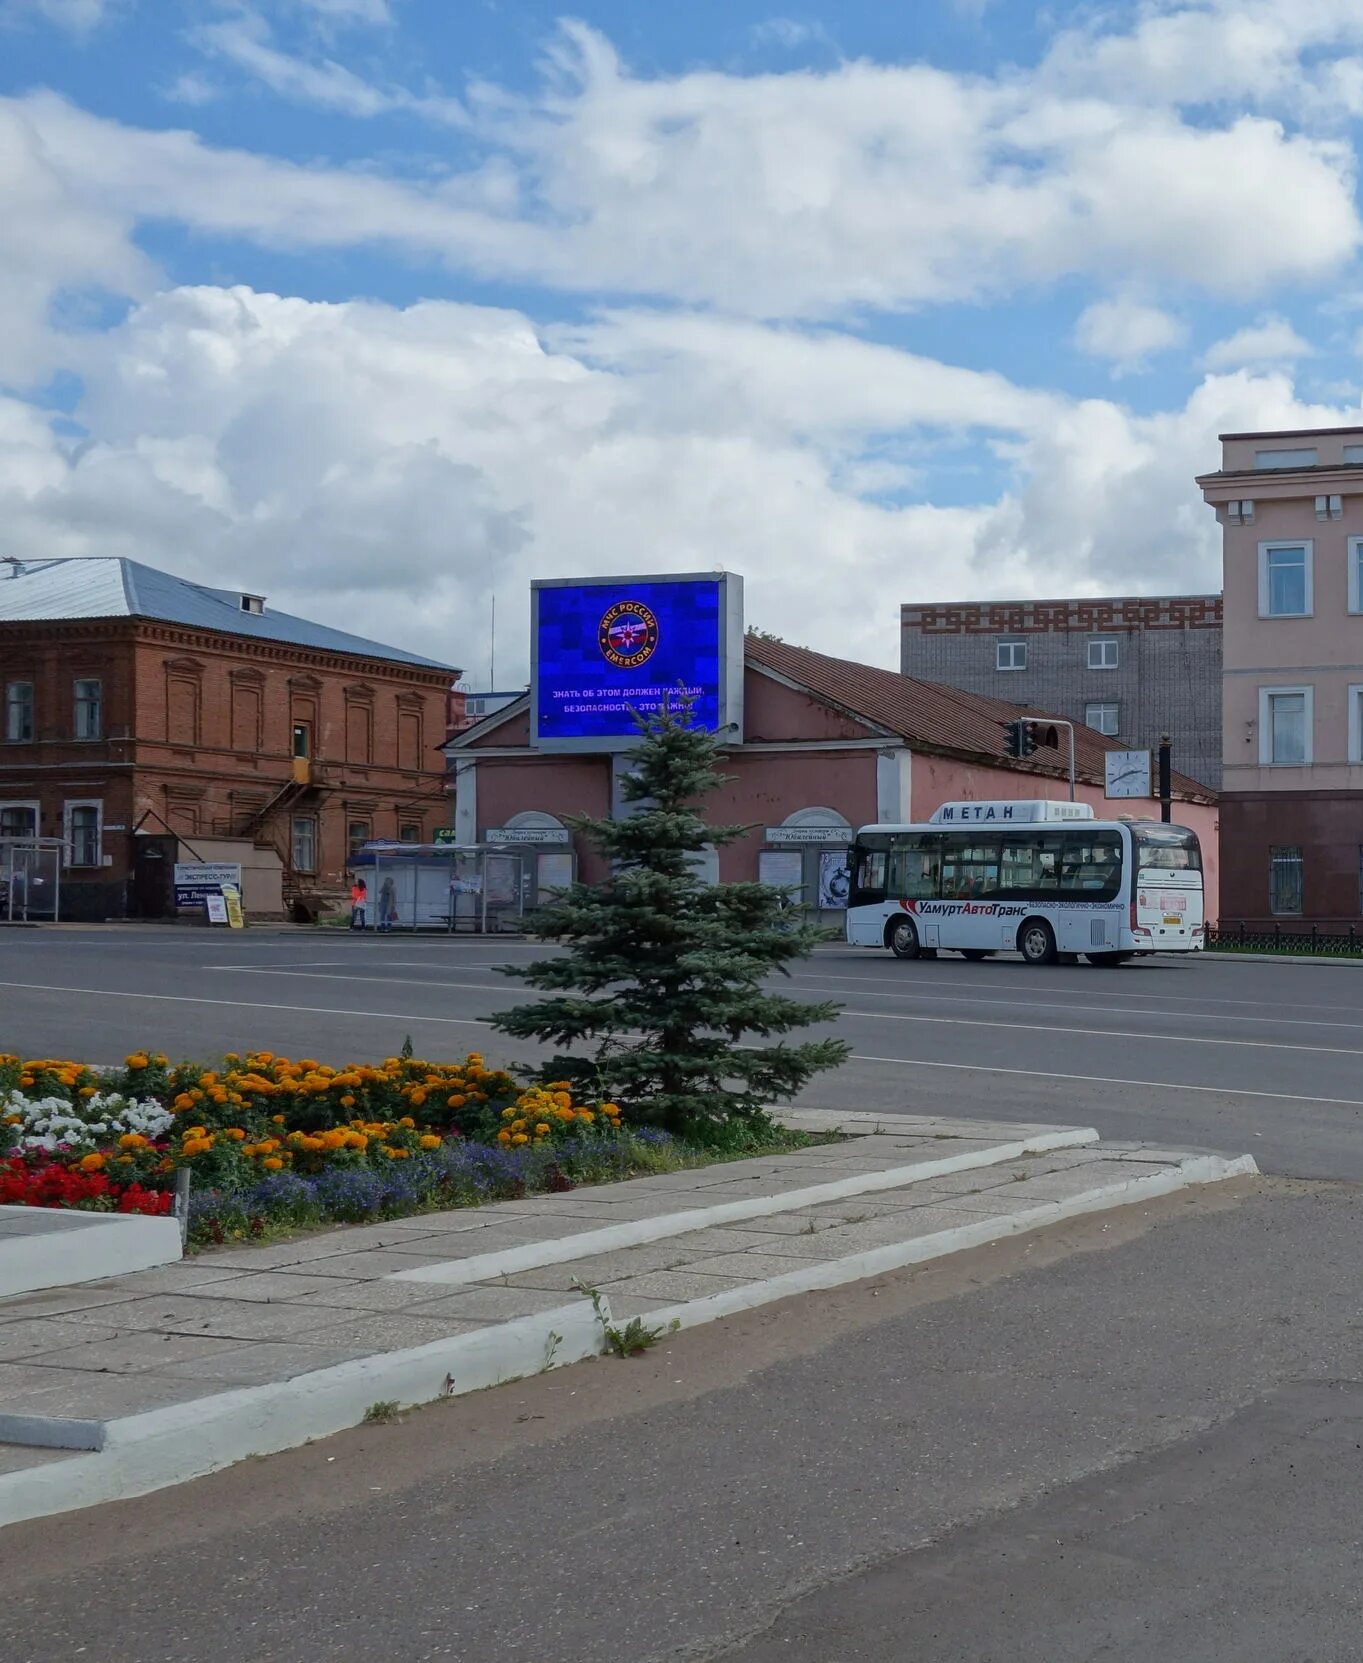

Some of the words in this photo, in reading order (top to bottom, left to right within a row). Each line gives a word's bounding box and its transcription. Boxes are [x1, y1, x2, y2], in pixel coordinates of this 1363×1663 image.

[601, 608, 618, 629] МЧС
[619, 603, 655, 628] РОССИИ
[605, 646, 652, 666] EMERCOM
[552, 690, 580, 698] ЗНАТЬ
[582, 689, 594, 698] ОБ
[596, 689, 620, 697] ЭТОМ
[622, 688, 660, 697] ДОЛЖЕН
[943, 806, 1013, 820] МЕТАН
[919, 901, 1027, 918] УдмуртАвтоТранс
